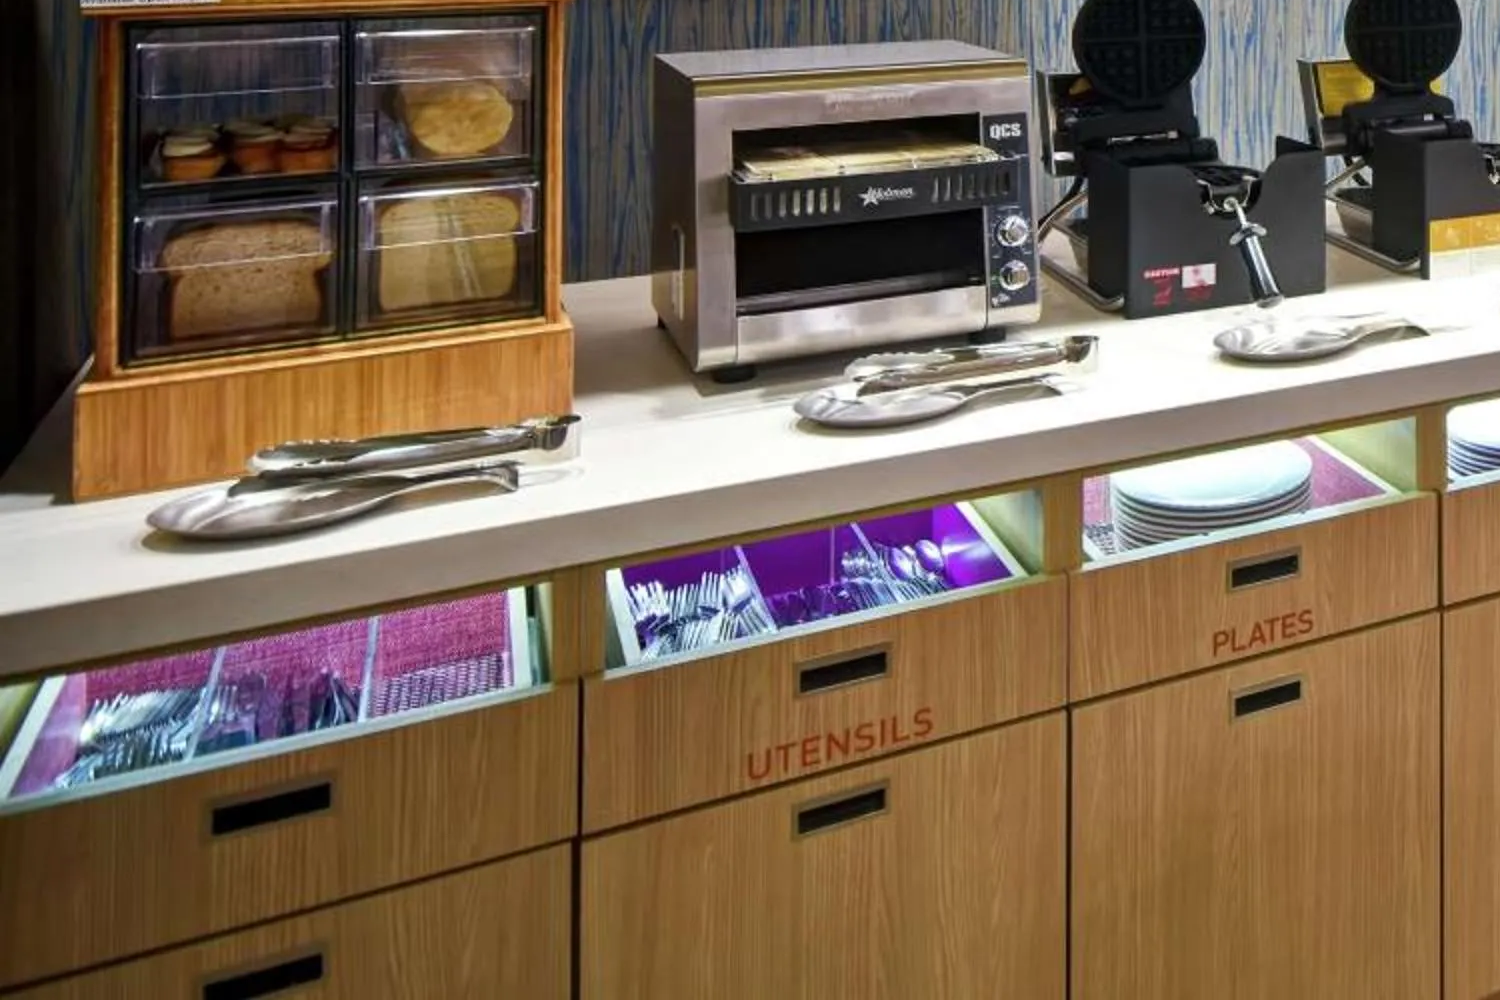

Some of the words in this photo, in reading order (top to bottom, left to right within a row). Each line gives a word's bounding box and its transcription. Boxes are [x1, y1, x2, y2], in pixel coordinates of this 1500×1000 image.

[989, 122, 1021, 140] QCS
[1212, 608, 1315, 658] PLATES
[747, 706, 934, 781] UTENSILS
